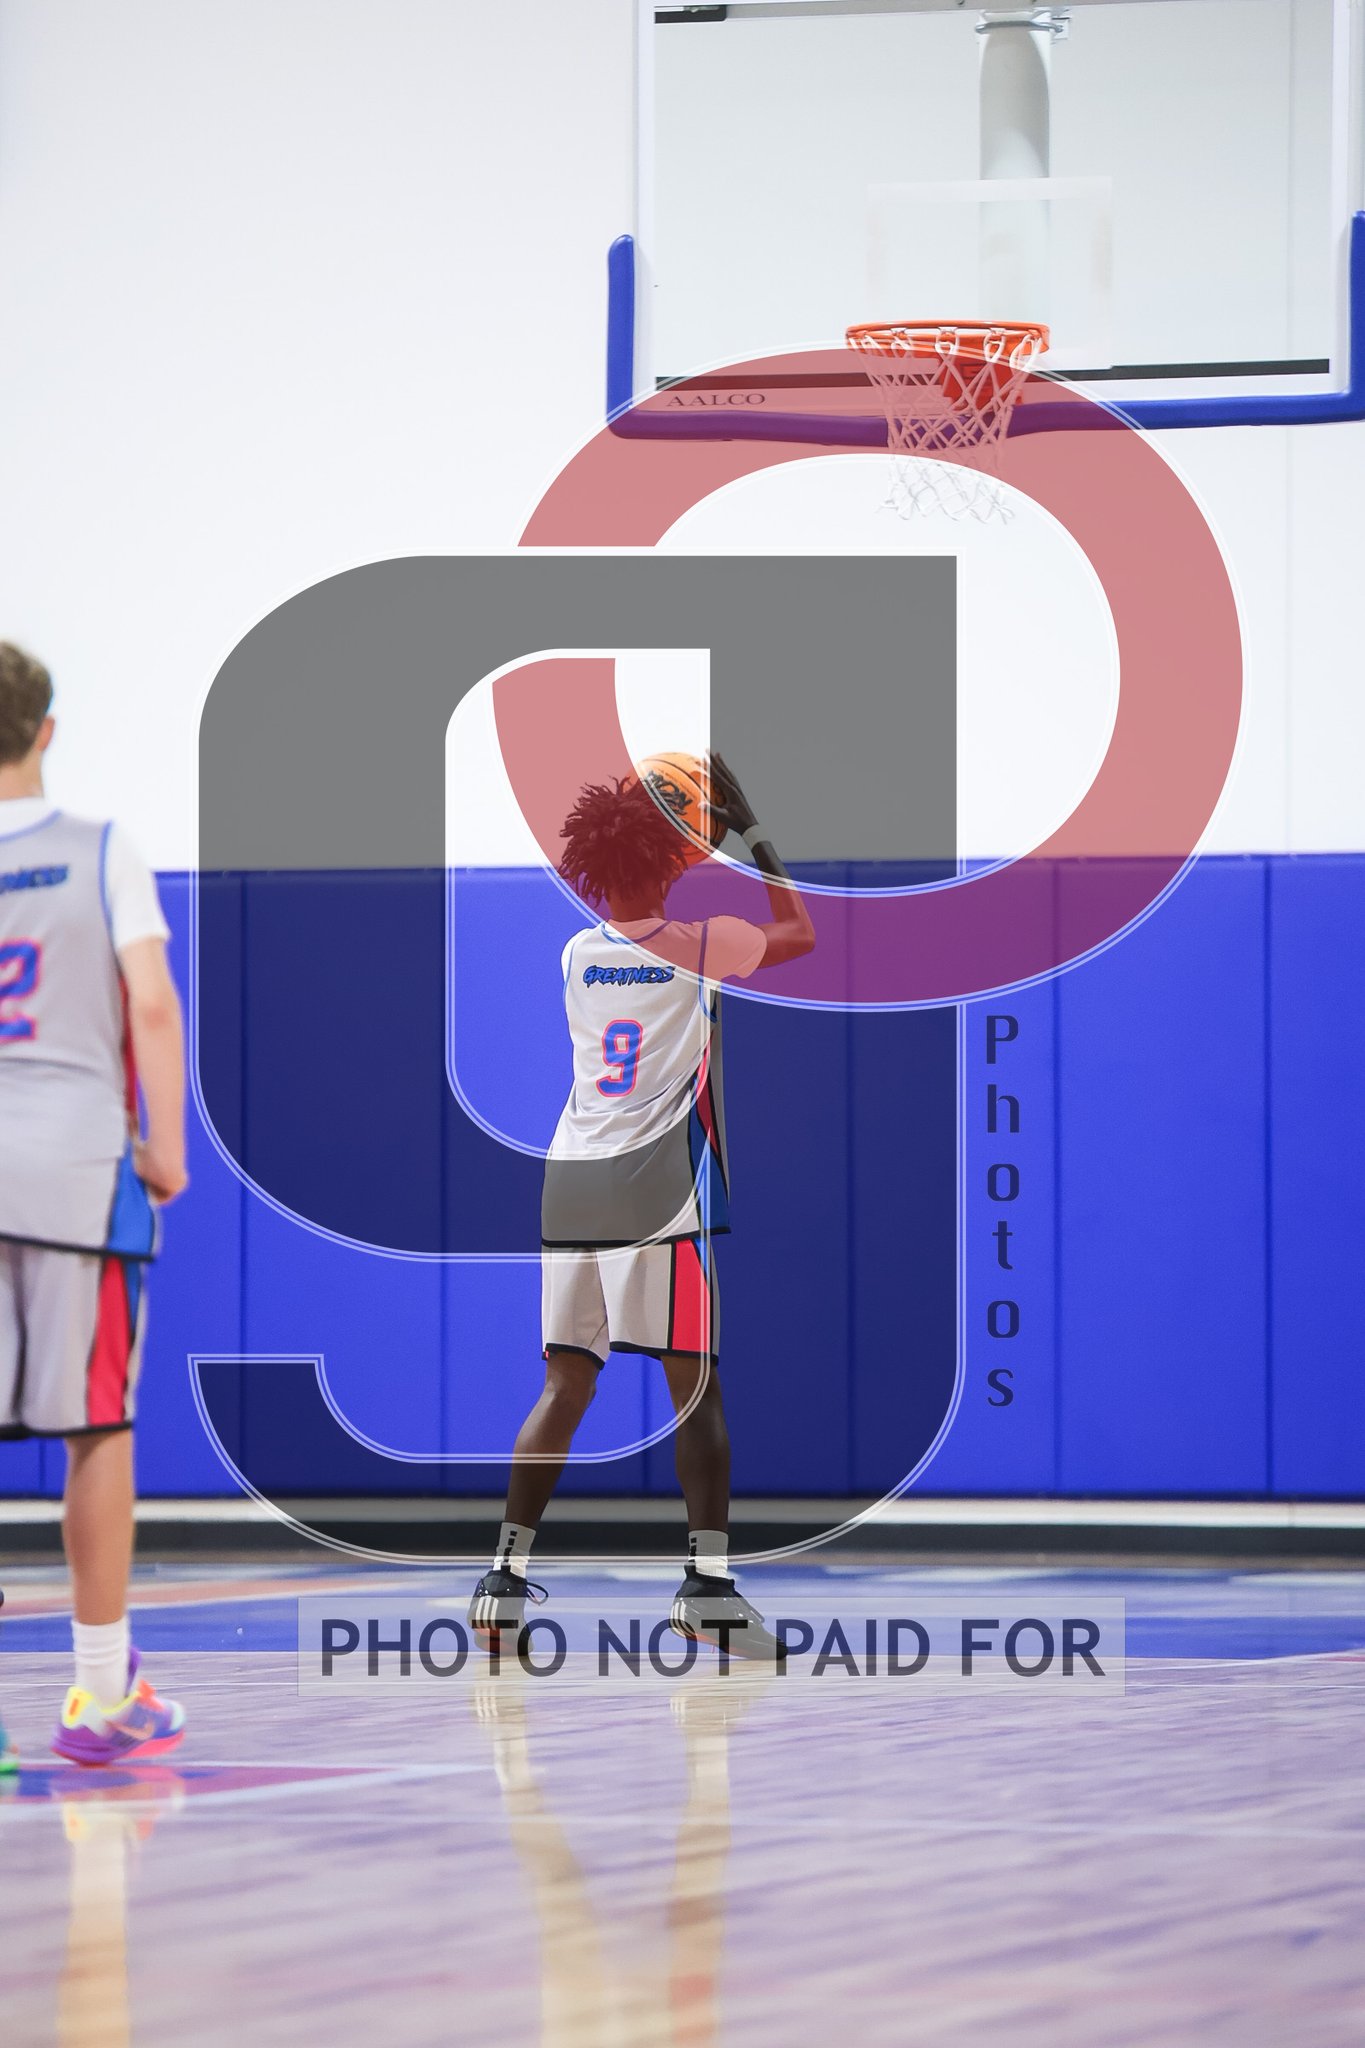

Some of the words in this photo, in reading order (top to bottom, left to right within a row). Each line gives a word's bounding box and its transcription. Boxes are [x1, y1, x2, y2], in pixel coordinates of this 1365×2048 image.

[667, 393, 766, 407] AALCO
[583, 964, 676, 988] GREATNESS
[596, 1018, 644, 1097] 9
